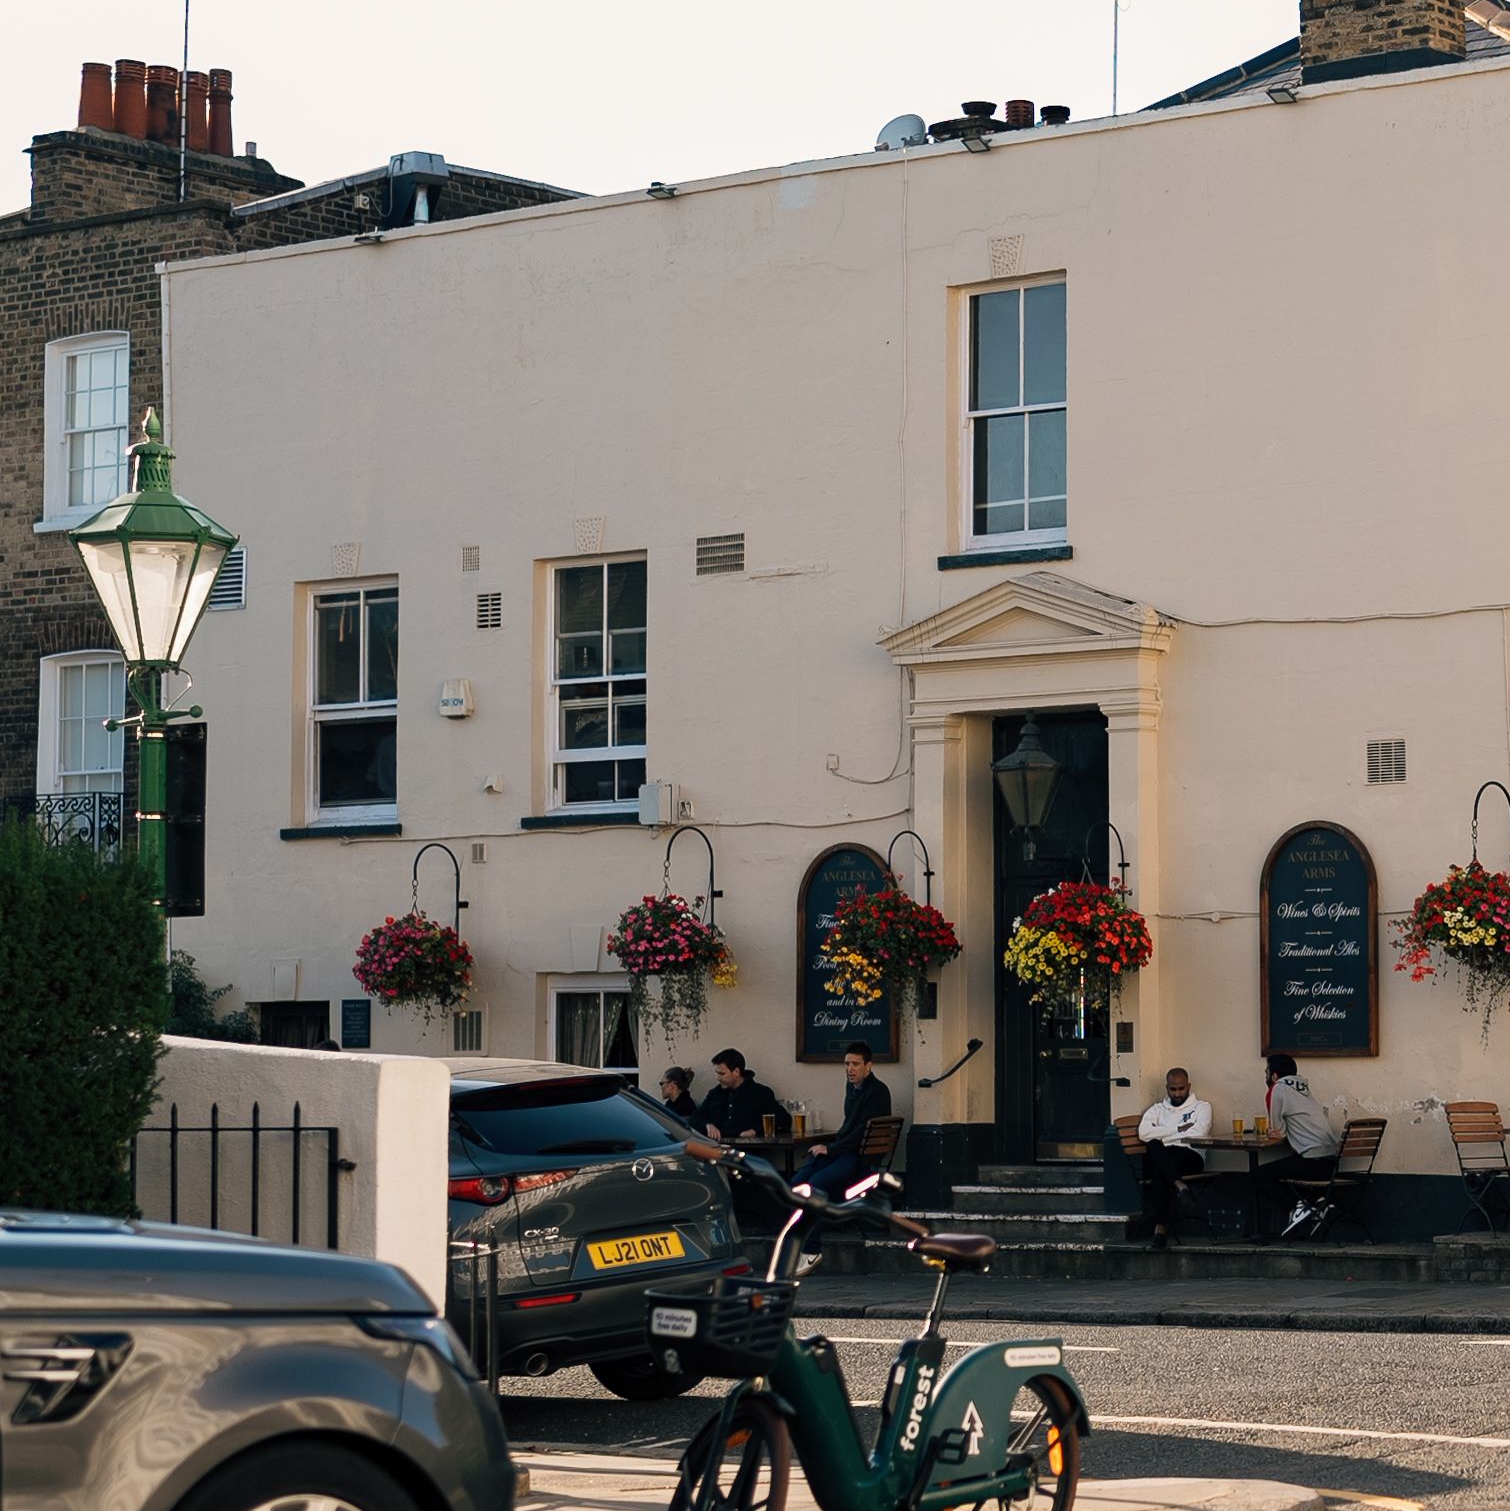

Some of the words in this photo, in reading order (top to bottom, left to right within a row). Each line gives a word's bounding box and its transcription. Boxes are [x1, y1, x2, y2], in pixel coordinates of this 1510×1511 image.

[1307, 834, 1327, 846] The
[1287, 849, 1350, 863] ANGLESEA
[821, 870, 876, 882] ANGLESEA
[1302, 866, 1336, 879] ARMS
[1277, 901, 1309, 919] Wines
[1311, 901, 1327, 918] &
[1328, 901, 1361, 923] Spirits
[1278, 942, 1335, 958] Traditional
[1334, 939, 1360, 957] Ales
[1283, 981, 1310, 997] Fine
[1311, 980, 1354, 998] Selection
[827, 995, 845, 1007] and
[813, 1011, 848, 1032] Dining
[850, 1011, 882, 1026] Room
[1294, 1008, 1305, 1025] of
[1305, 1001, 1347, 1020] Whiskies
[524, 1226, 560, 1238] CX-30
[598, 1242, 640, 1265] LJ21
[640, 1237, 673, 1258] ONT
[900, 1365, 935, 1451] forest
